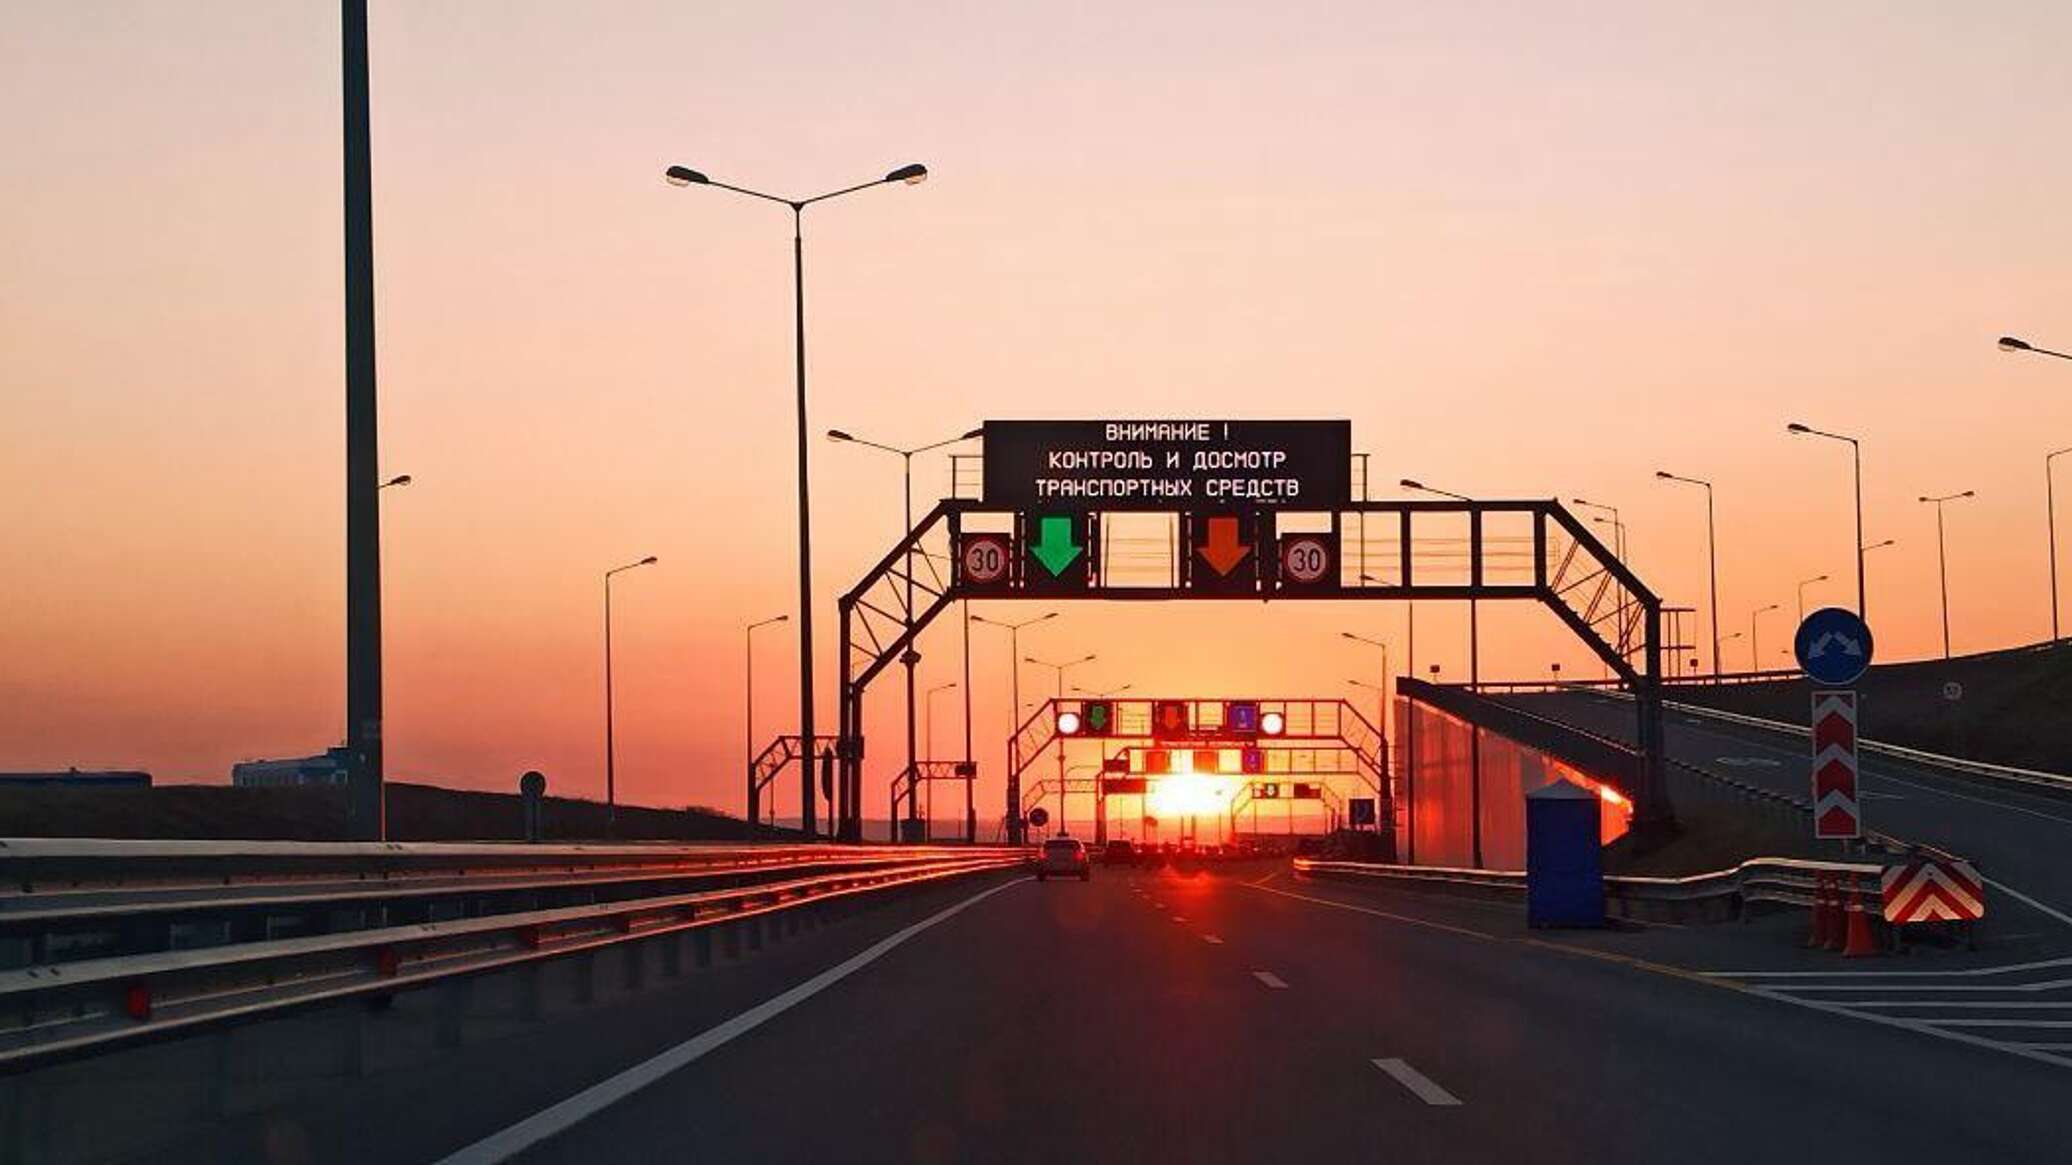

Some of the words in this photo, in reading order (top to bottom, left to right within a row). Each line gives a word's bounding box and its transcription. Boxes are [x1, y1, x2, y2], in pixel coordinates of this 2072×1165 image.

[1105, 423, 1210, 441] ВНИМАНИЕ
[1049, 451, 1153, 470] КОНТРОЛЬ
[1166, 451, 1180, 470] И
[1192, 451, 1287, 471] ДОСМОТР
[1035, 479, 1192, 498] ТРАНСПОРТНЫХ
[1206, 479, 1299, 498] СРЕДСТВ
[971, 548, 999, 572] 30
[1293, 548, 1321, 572] 30
